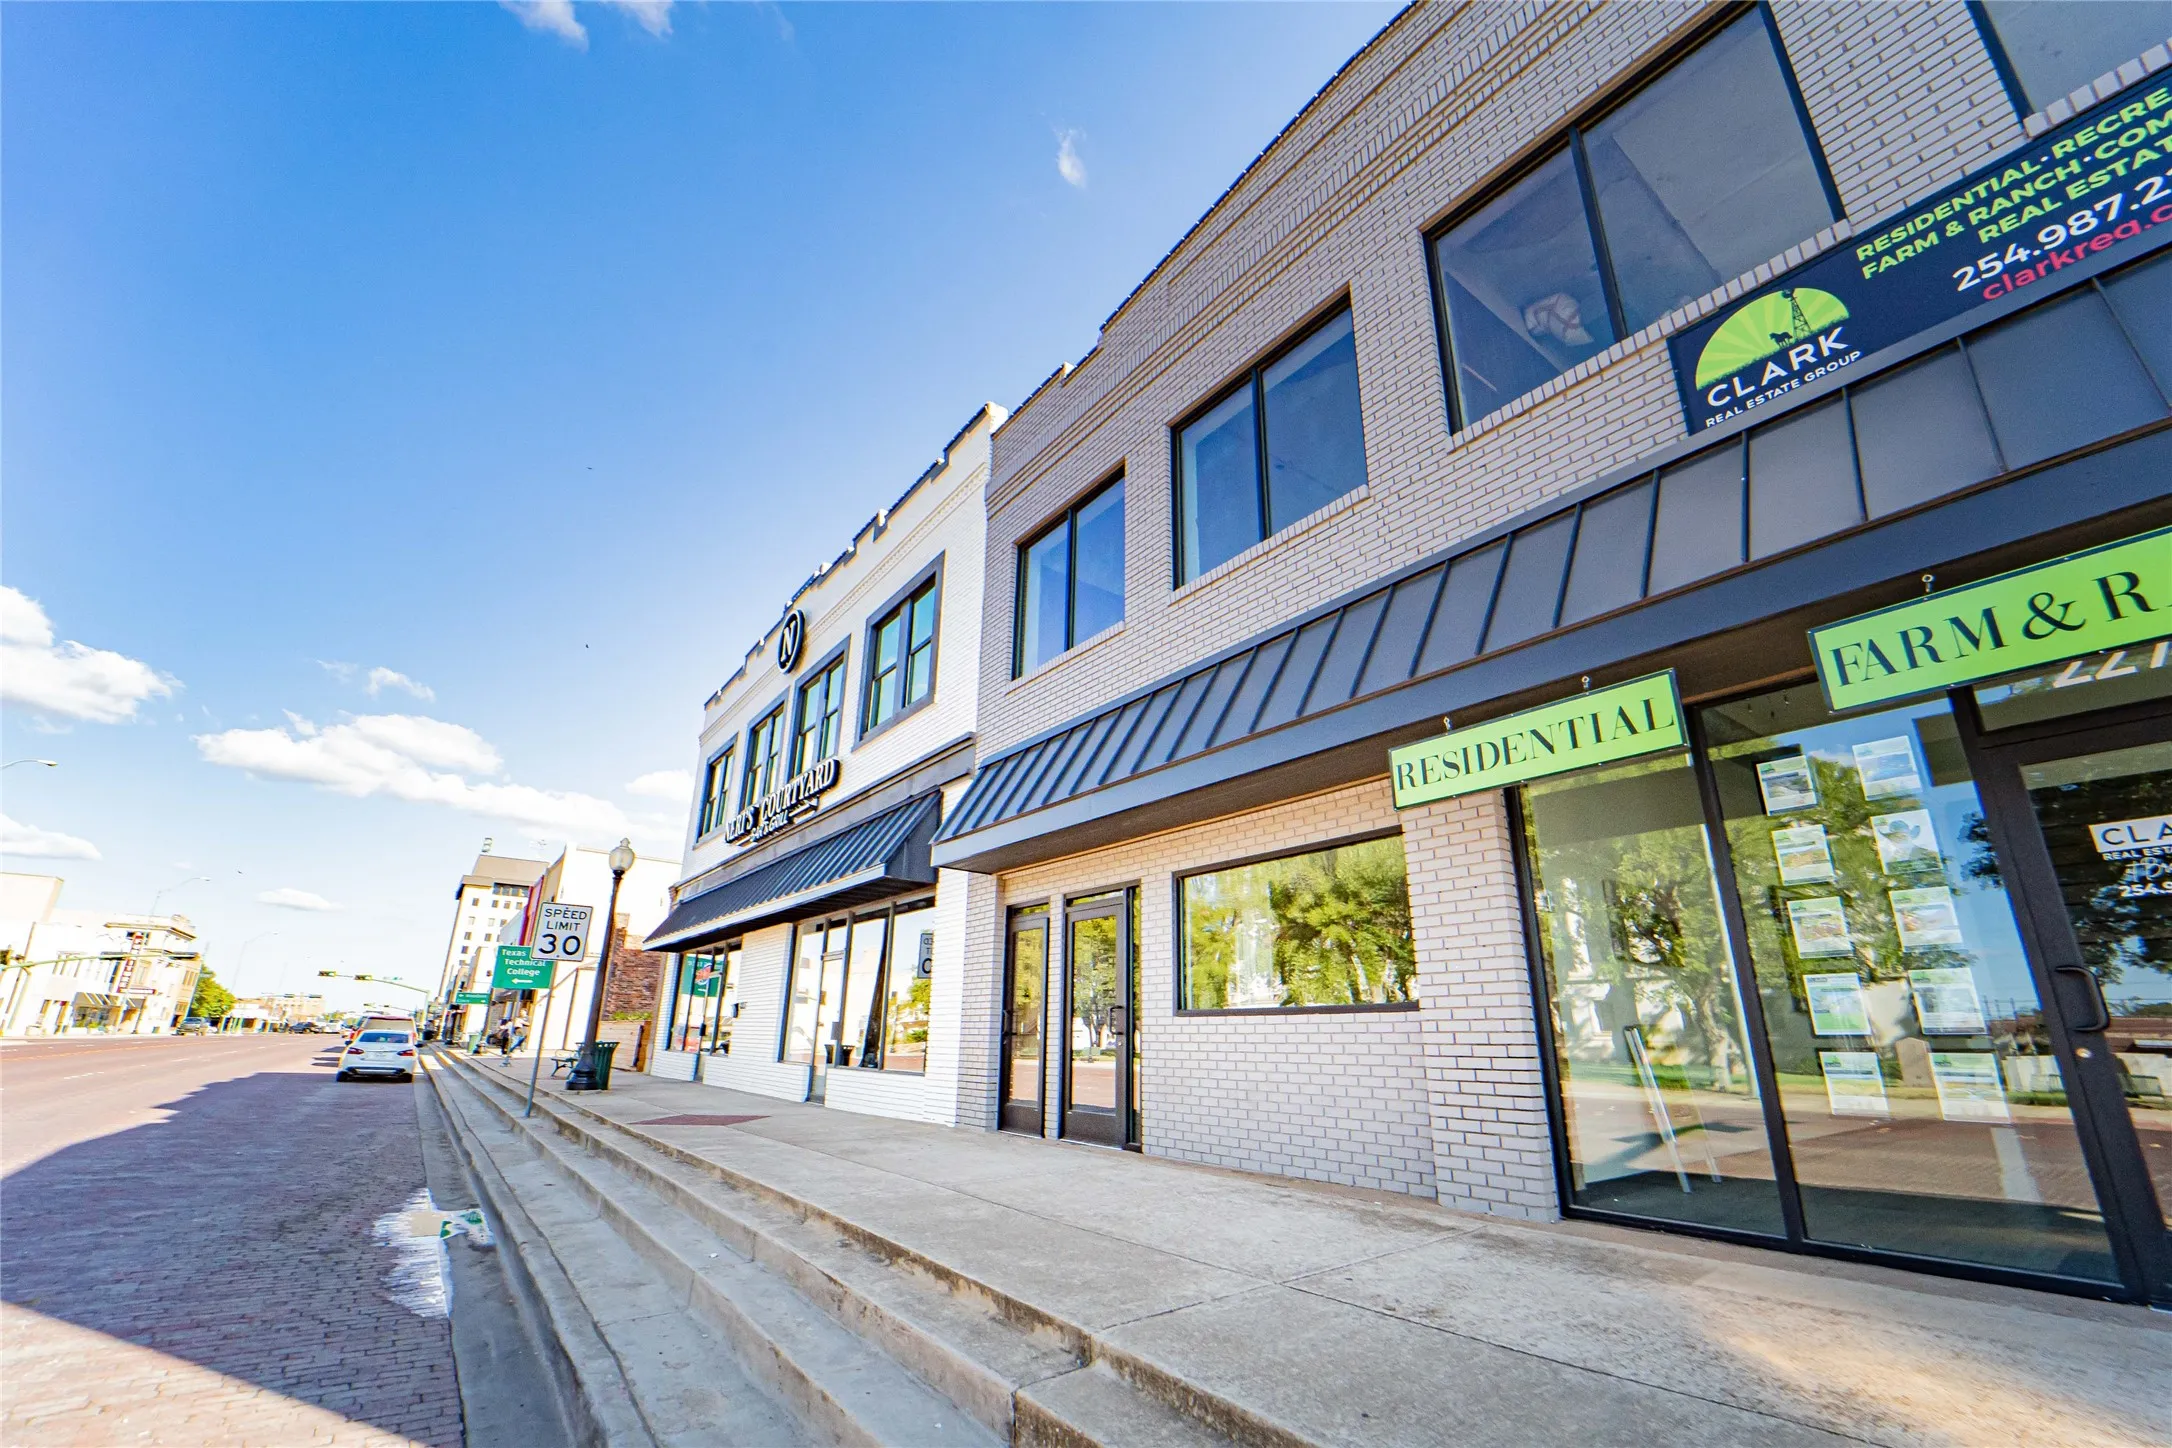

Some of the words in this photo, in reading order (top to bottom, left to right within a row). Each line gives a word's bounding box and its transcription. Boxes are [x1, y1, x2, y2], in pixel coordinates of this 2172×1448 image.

[1856, 160, 2042, 261] RESIDENTIAL
[2052, 87, 2172, 159] RECRE
[1862, 231, 1940, 280] FARM
[1945, 220, 1965, 237] &
[1968, 159, 2082, 225] RANCH
[1953, 168, 2172, 291] 254.987.2
[1978, 197, 2063, 244] REAL
[1705, 407, 1743, 428] REAL
[1746, 378, 1800, 409] ESTATE
[1804, 350, 1862, 382] GROUP
[1707, 326, 1849, 407] CLARK
[1829, 605, 2010, 687] FARM
[2022, 592, 2087, 640] &
[1396, 697, 1675, 791] RESIDENTIAL
[761, 758, 837, 822] COURTYARD
[2102, 849, 2142, 861] REAL
[544, 907, 588, 920] SPEED
[546, 920, 581, 931] LIMIT
[501, 949, 527, 957] Texas
[504, 958, 547, 967] Technical
[538, 933, 581, 956] 30
[506, 968, 541, 977] College
